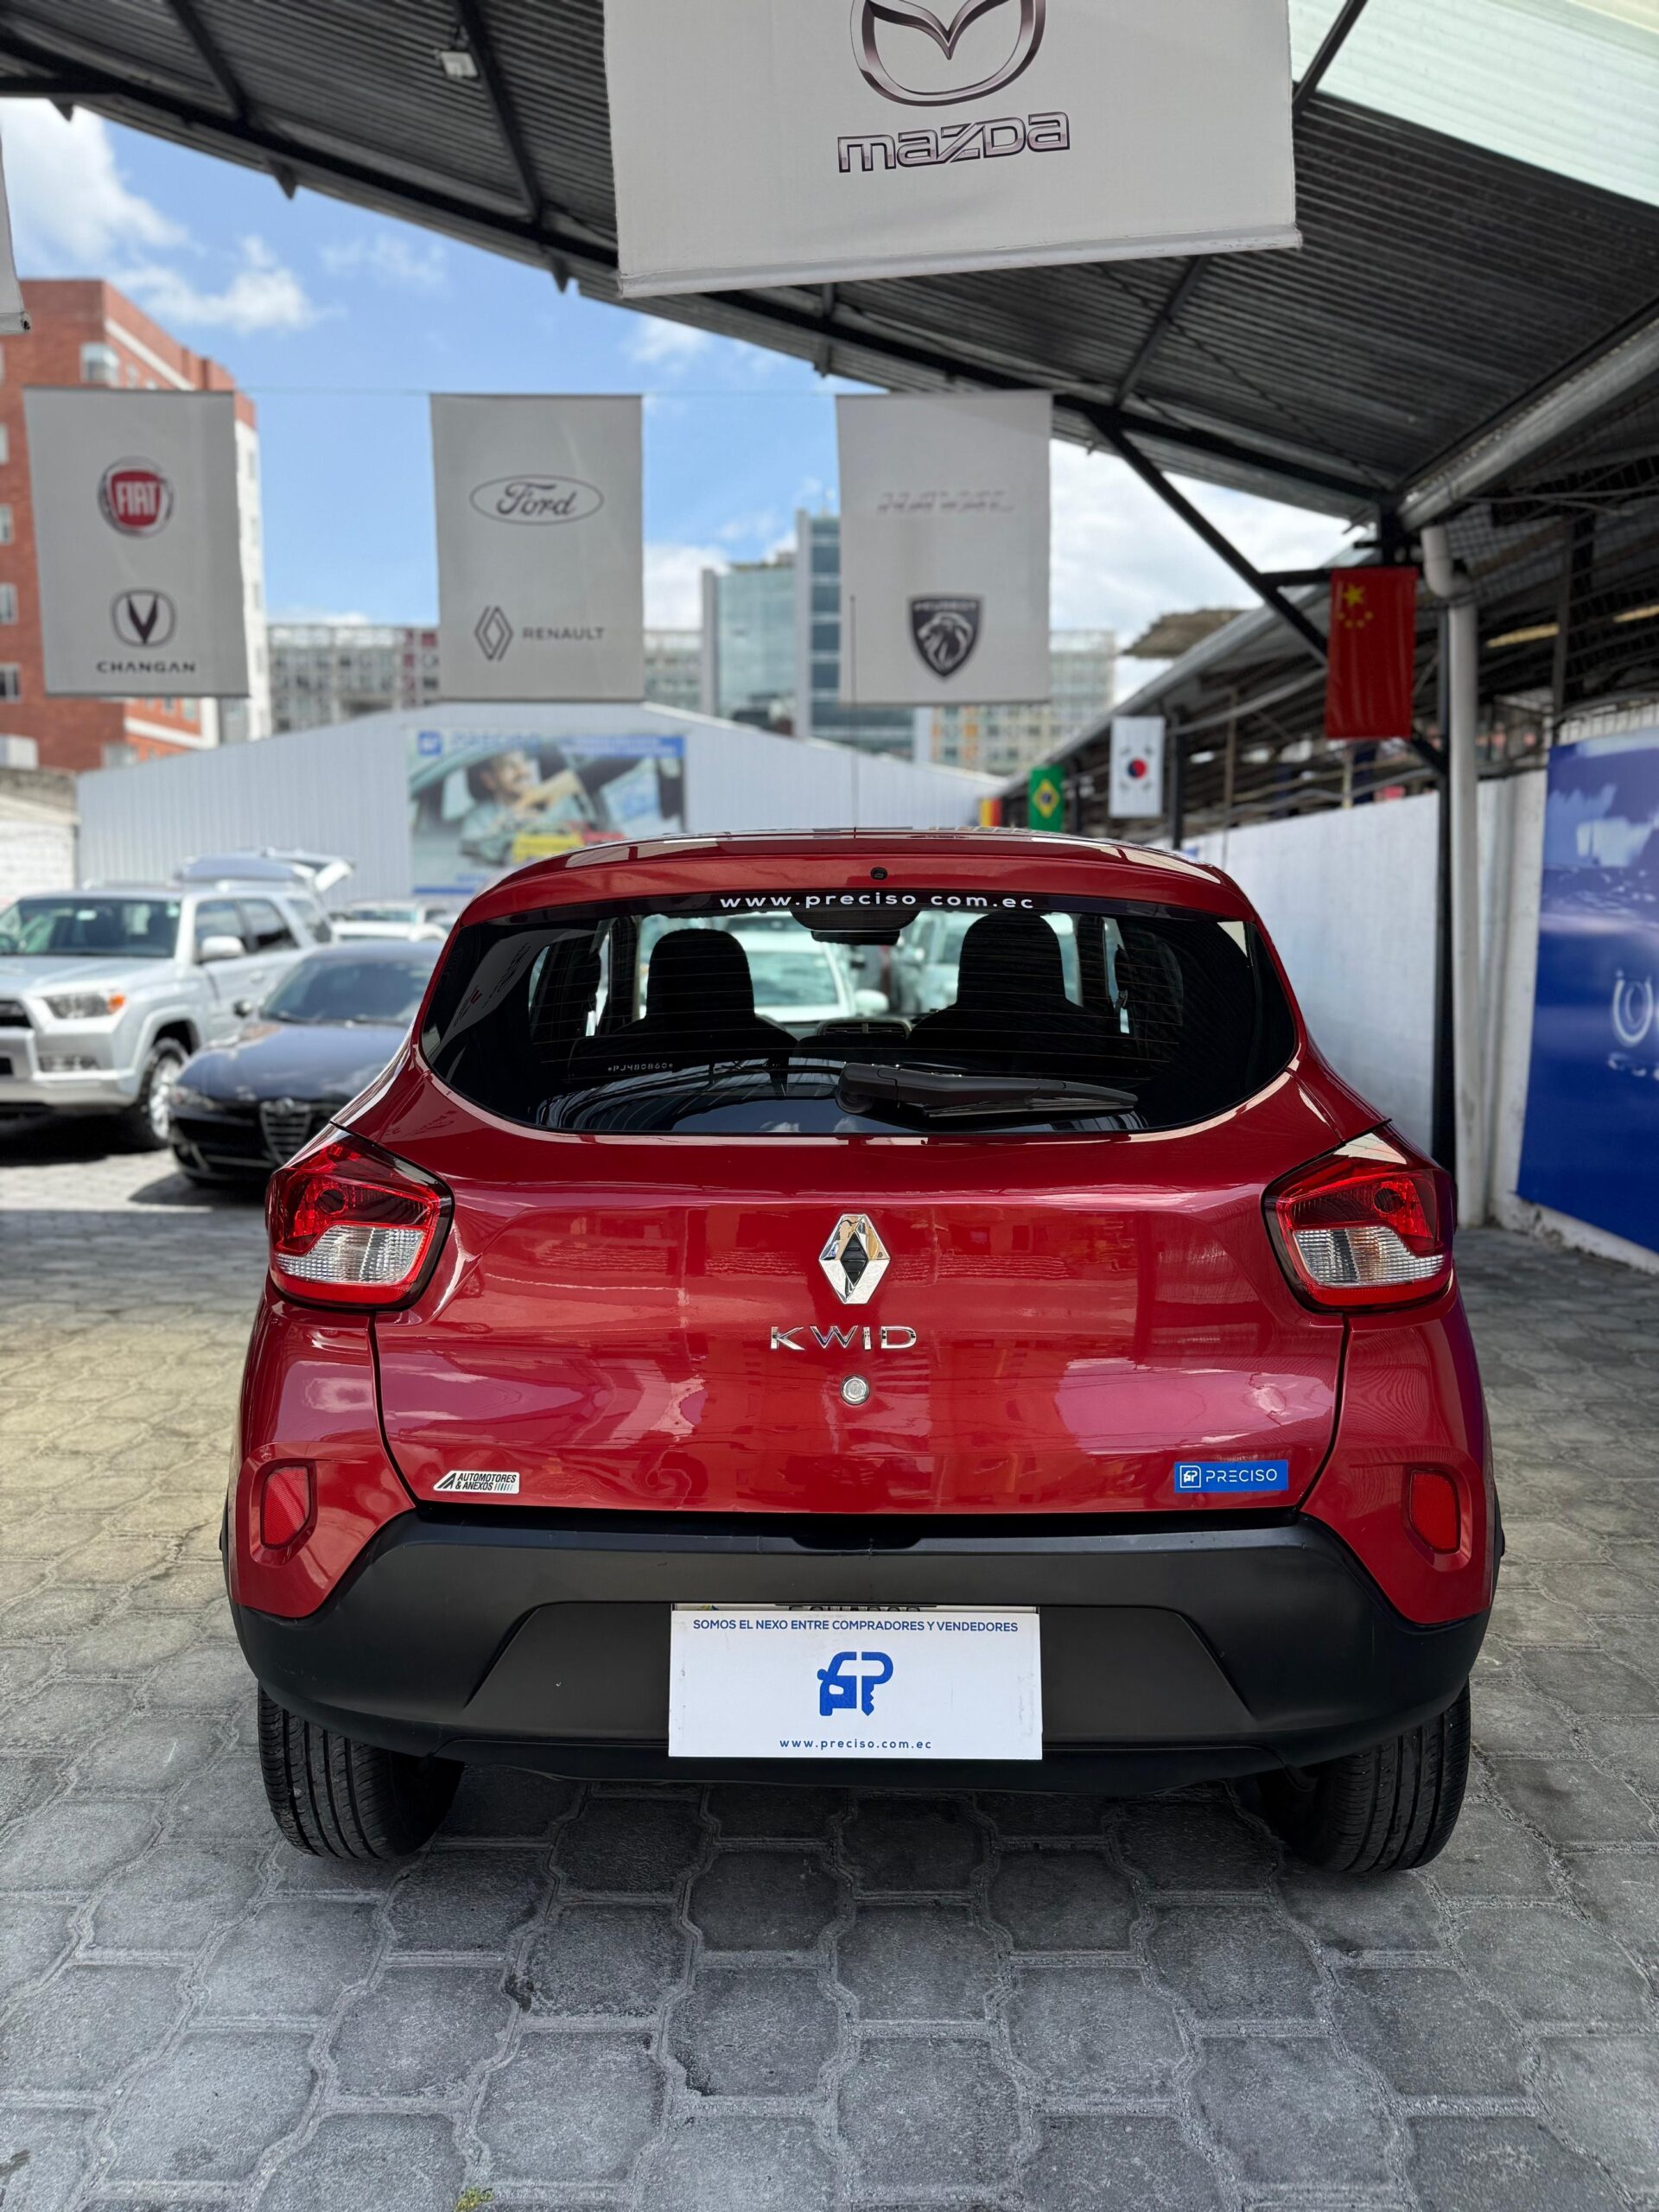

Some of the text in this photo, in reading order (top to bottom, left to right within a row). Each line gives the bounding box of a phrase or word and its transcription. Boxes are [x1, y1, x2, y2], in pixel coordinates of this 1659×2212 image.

[115, 481, 159, 516] FIAT
[496, 481, 576, 515] Ford
[522, 626, 604, 640] RENAULT
[96, 661, 195, 674] CHANGAN
[770, 1325, 917, 1351] KWID
[458, 1472, 517, 1483] AUTOMOTORES
[1205, 1468, 1278, 1483] PRECISO
[455, 1481, 493, 1491] & ANEXOS
[693, 1619, 1019, 1632] SOMOS EL NEXO ENTRE COMPRADORES Y VENDEDORES
[779, 1738, 932, 1750] www.preciso.com.ec
